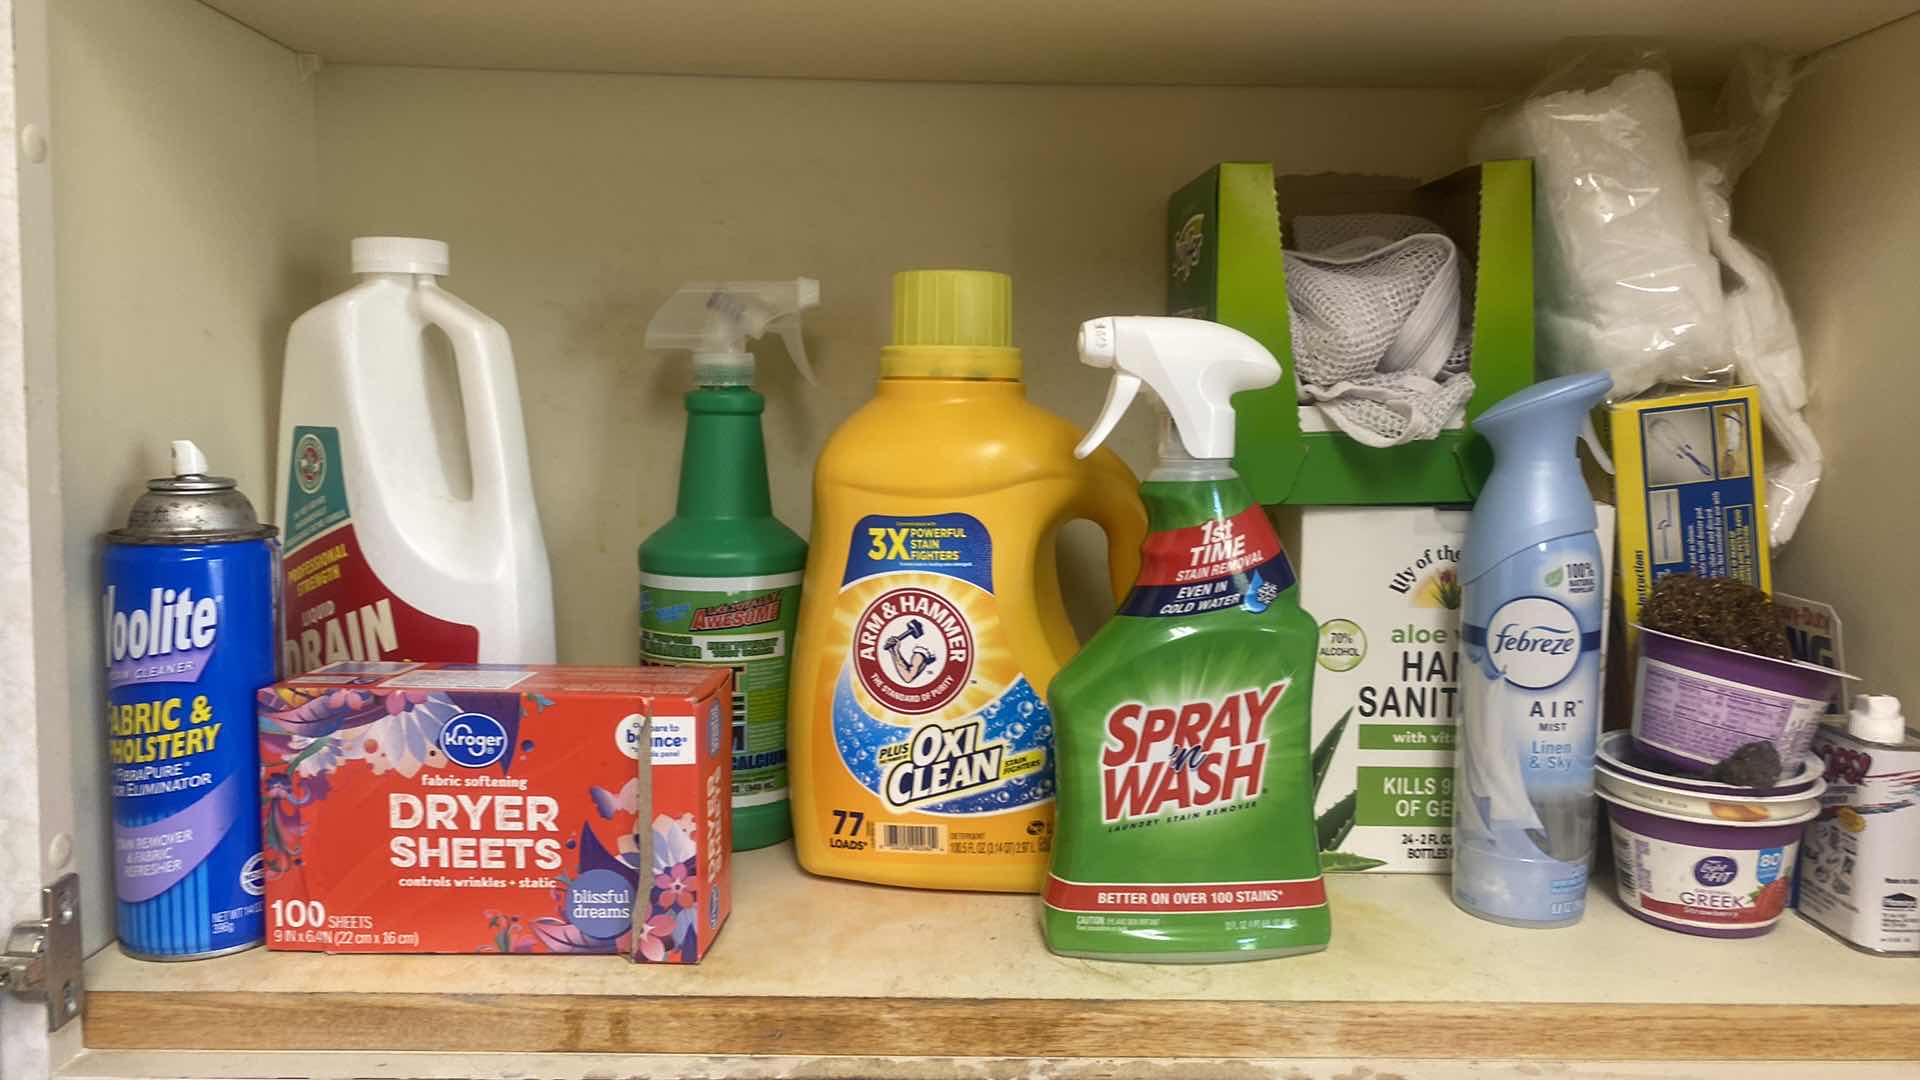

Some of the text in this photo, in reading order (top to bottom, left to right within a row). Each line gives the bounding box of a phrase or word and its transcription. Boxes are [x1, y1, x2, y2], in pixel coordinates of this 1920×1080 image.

[911, 528, 967, 538] POWERFUL
[1200, 520, 1233, 546] 1st
[868, 528, 911, 560] 3X
[911, 540, 940, 549] STAIN
[1190, 535, 1246, 566] TIME
[911, 551, 960, 560] FIGHTERS
[1416, 549, 1433, 569] of
[1176, 550, 1265, 583] STAIN REMOVAL
[1566, 561, 1595, 578] 100%
[1177, 580, 1229, 599] EVEN IN
[1160, 602, 1195, 617] COLD
[1198, 593, 1242, 612] WATER
[690, 601, 779, 630] AWESOME
[860, 595, 967, 662] ARM & HAMMER
[1391, 624, 1448, 644] aloe
[284, 598, 399, 679] DRAIN
[1331, 633, 1353, 644] 70%
[1494, 624, 1576, 655] febreze
[1320, 648, 1361, 657] ALCOHOL
[135, 661, 193, 679] CLEANER
[108, 695, 213, 736] ABRIC &
[1530, 701, 1577, 718] AIR
[1102, 681, 1287, 768] SPRAY
[1539, 723, 1568, 732] MIST
[109, 723, 222, 764] HOLSTERY
[445, 724, 504, 757] Kroger
[912, 723, 979, 767] OXI
[1392, 731, 1428, 744] with
[880, 743, 909, 759] PLUS
[1531, 741, 1571, 754] Linen
[1529, 756, 1574, 772] & Sky
[421, 775, 528, 791] fabric softening
[887, 745, 1003, 806] CLEAN
[1103, 743, 1268, 821] WASH
[1383, 777, 1437, 796] KILLS
[389, 793, 560, 832] DRYER
[1108, 801, 1258, 833] LAUNDRY STAIN REMOVER
[1395, 800, 1422, 817] OF
[832, 810, 864, 837] 77
[390, 836, 562, 870] SHEETS
[1760, 853, 1780, 867] 80
[399, 877, 452, 888] controls
[454, 877, 507, 889] wrinkles
[519, 878, 557, 889] static
[572, 889, 631, 905] blissful
[1097, 892, 1148, 905] BETTER
[1151, 892, 1170, 905] ON
[1173, 892, 1208, 905] OVER
[1210, 891, 1234, 904] 100
[1679, 892, 1746, 907] GREEK
[271, 898, 374, 929] 100 SHEETS
[572, 905, 631, 919] dreams
[273, 930, 283, 943] 9
